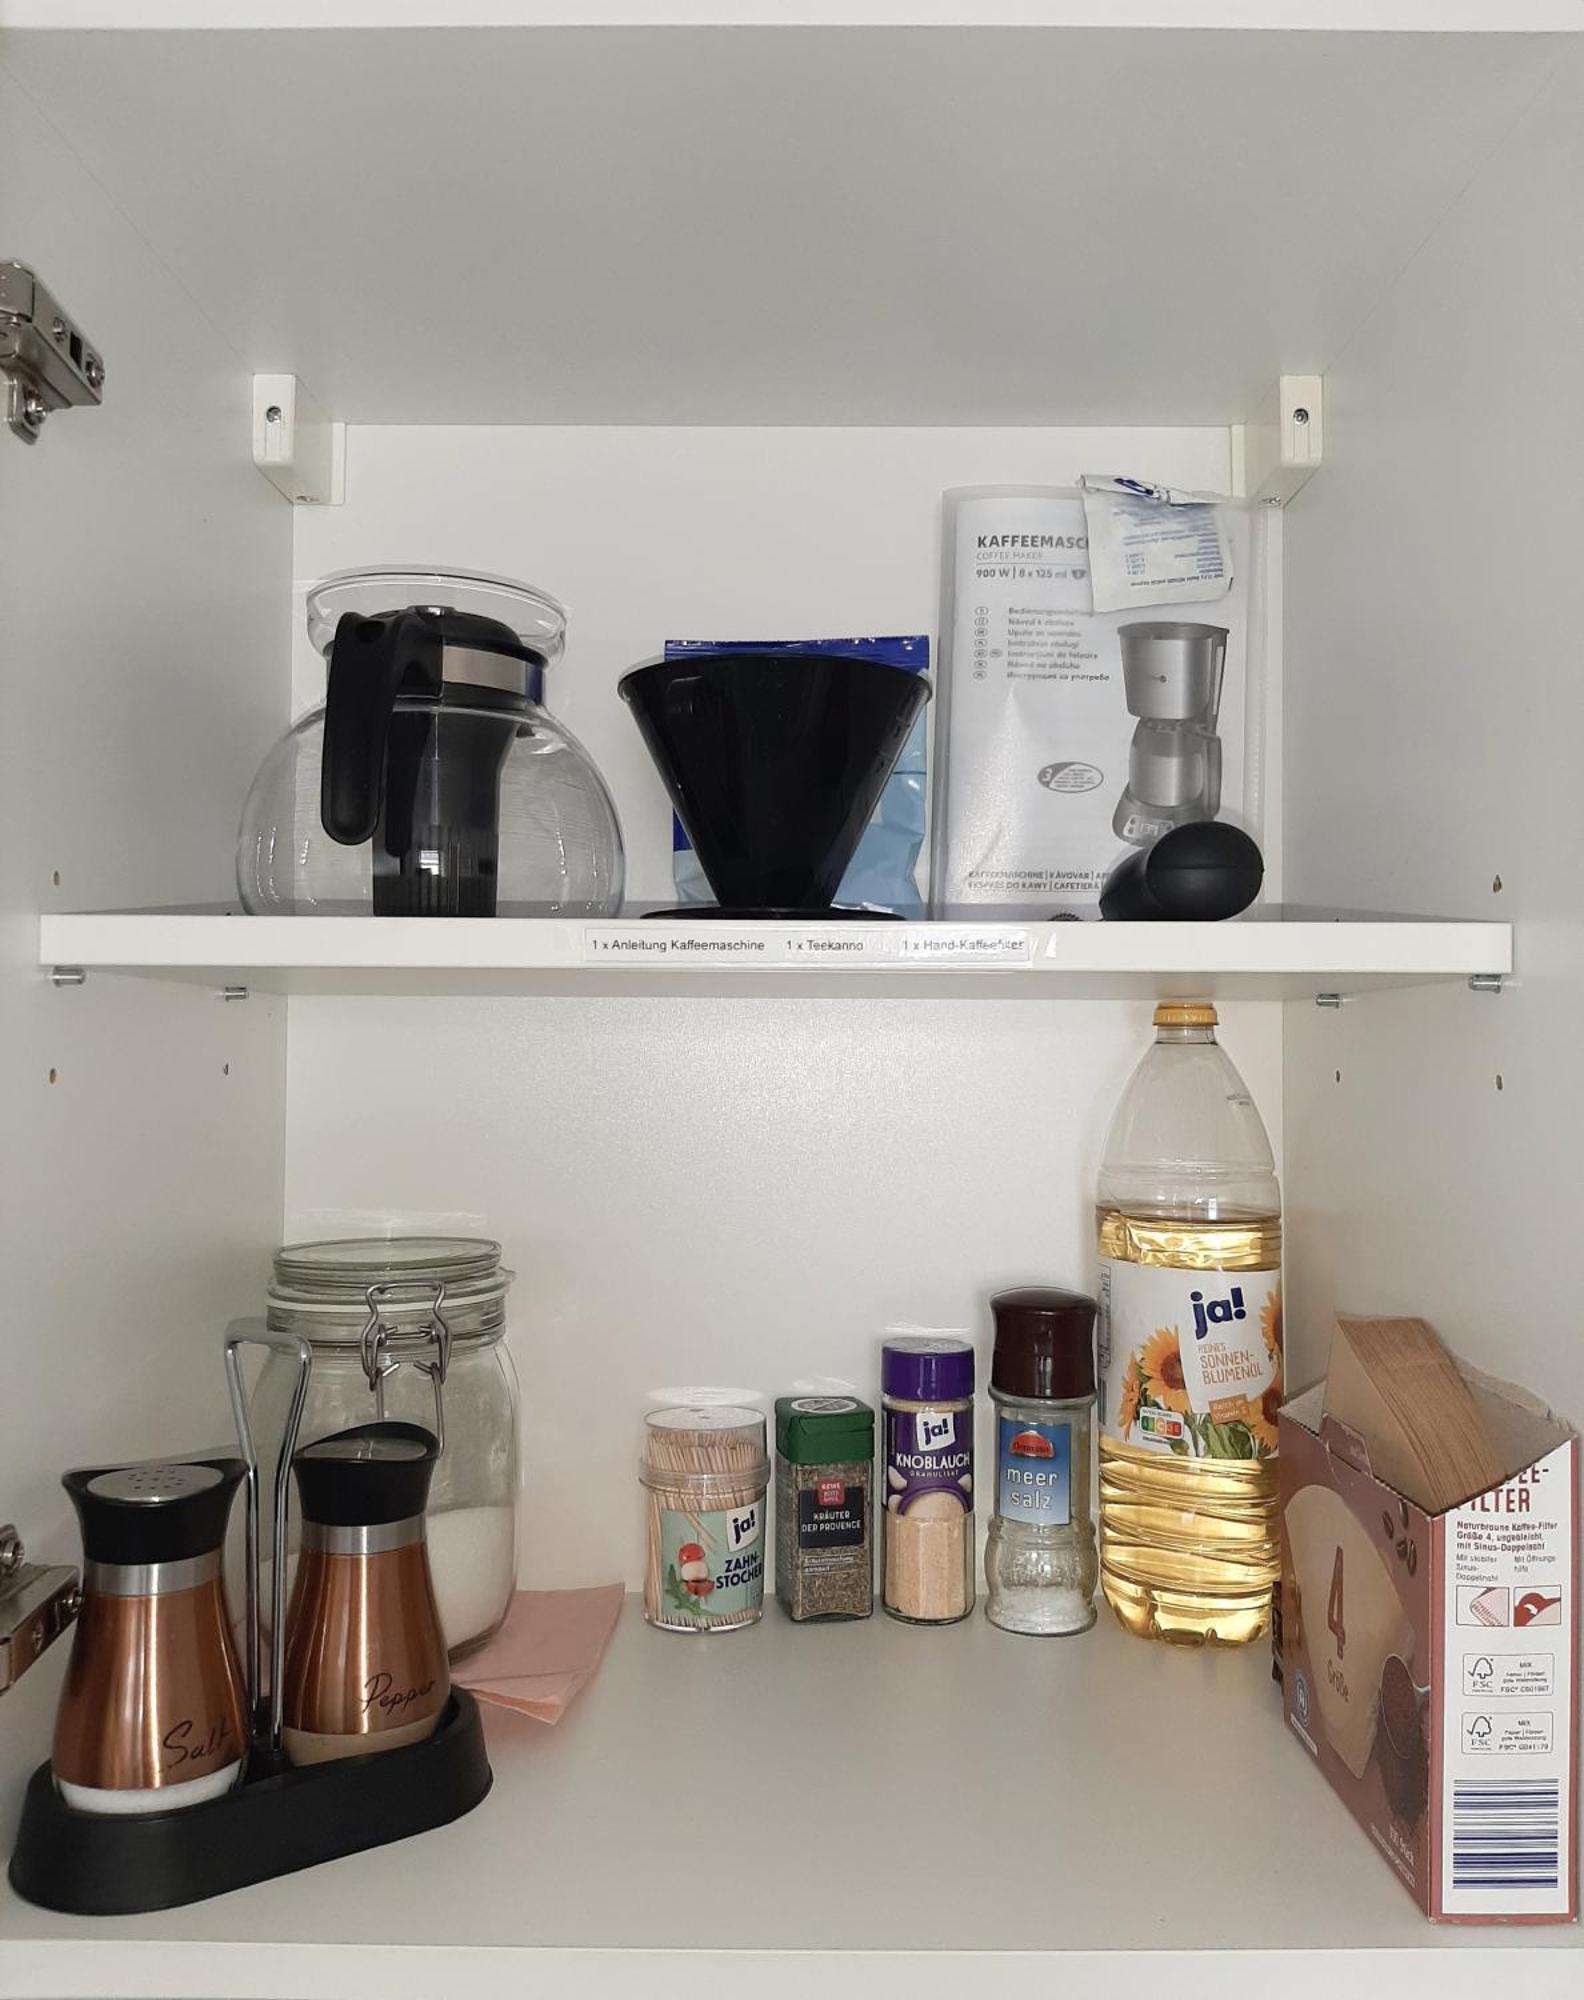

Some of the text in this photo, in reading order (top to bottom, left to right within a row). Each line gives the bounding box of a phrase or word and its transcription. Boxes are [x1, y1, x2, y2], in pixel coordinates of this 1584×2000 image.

[977, 534, 1089, 551] KAFFEEMASC
[976, 568, 996, 578] 900
[999, 568, 1010, 578] W
[592, 938, 765, 953] 1 x Anleitung Kaffeemaschine
[787, 939, 792, 950] 1
[797, 942, 803, 950] x
[903, 939, 908, 950] 1
[913, 942, 920, 950] x
[1190, 1286, 1247, 1341] ja!
[1199, 1349, 1254, 1369] SONNEN-
[923, 1417, 949, 1446] ja!
[895, 1451, 970, 1470] KNOBLAUCH
[1007, 1468, 1058, 1487] meer
[1011, 1489, 1052, 1510] salz
[1471, 1489, 1531, 1513] ILTER
[812, 1509, 851, 1521] KRÄUTER
[732, 1508, 756, 1545] ja!
[801, 1520, 862, 1533] DER PROVENCE
[1456, 1520, 1558, 1532] Naturbraune Kaffee-Filter
[1456, 1531, 1483, 1540] Größe
[1456, 1542, 1472, 1550] mit
[724, 1551, 760, 1573] ZAHN-
[1327, 1545, 1346, 1661] 4
[161, 1719, 233, 1770] Salt
